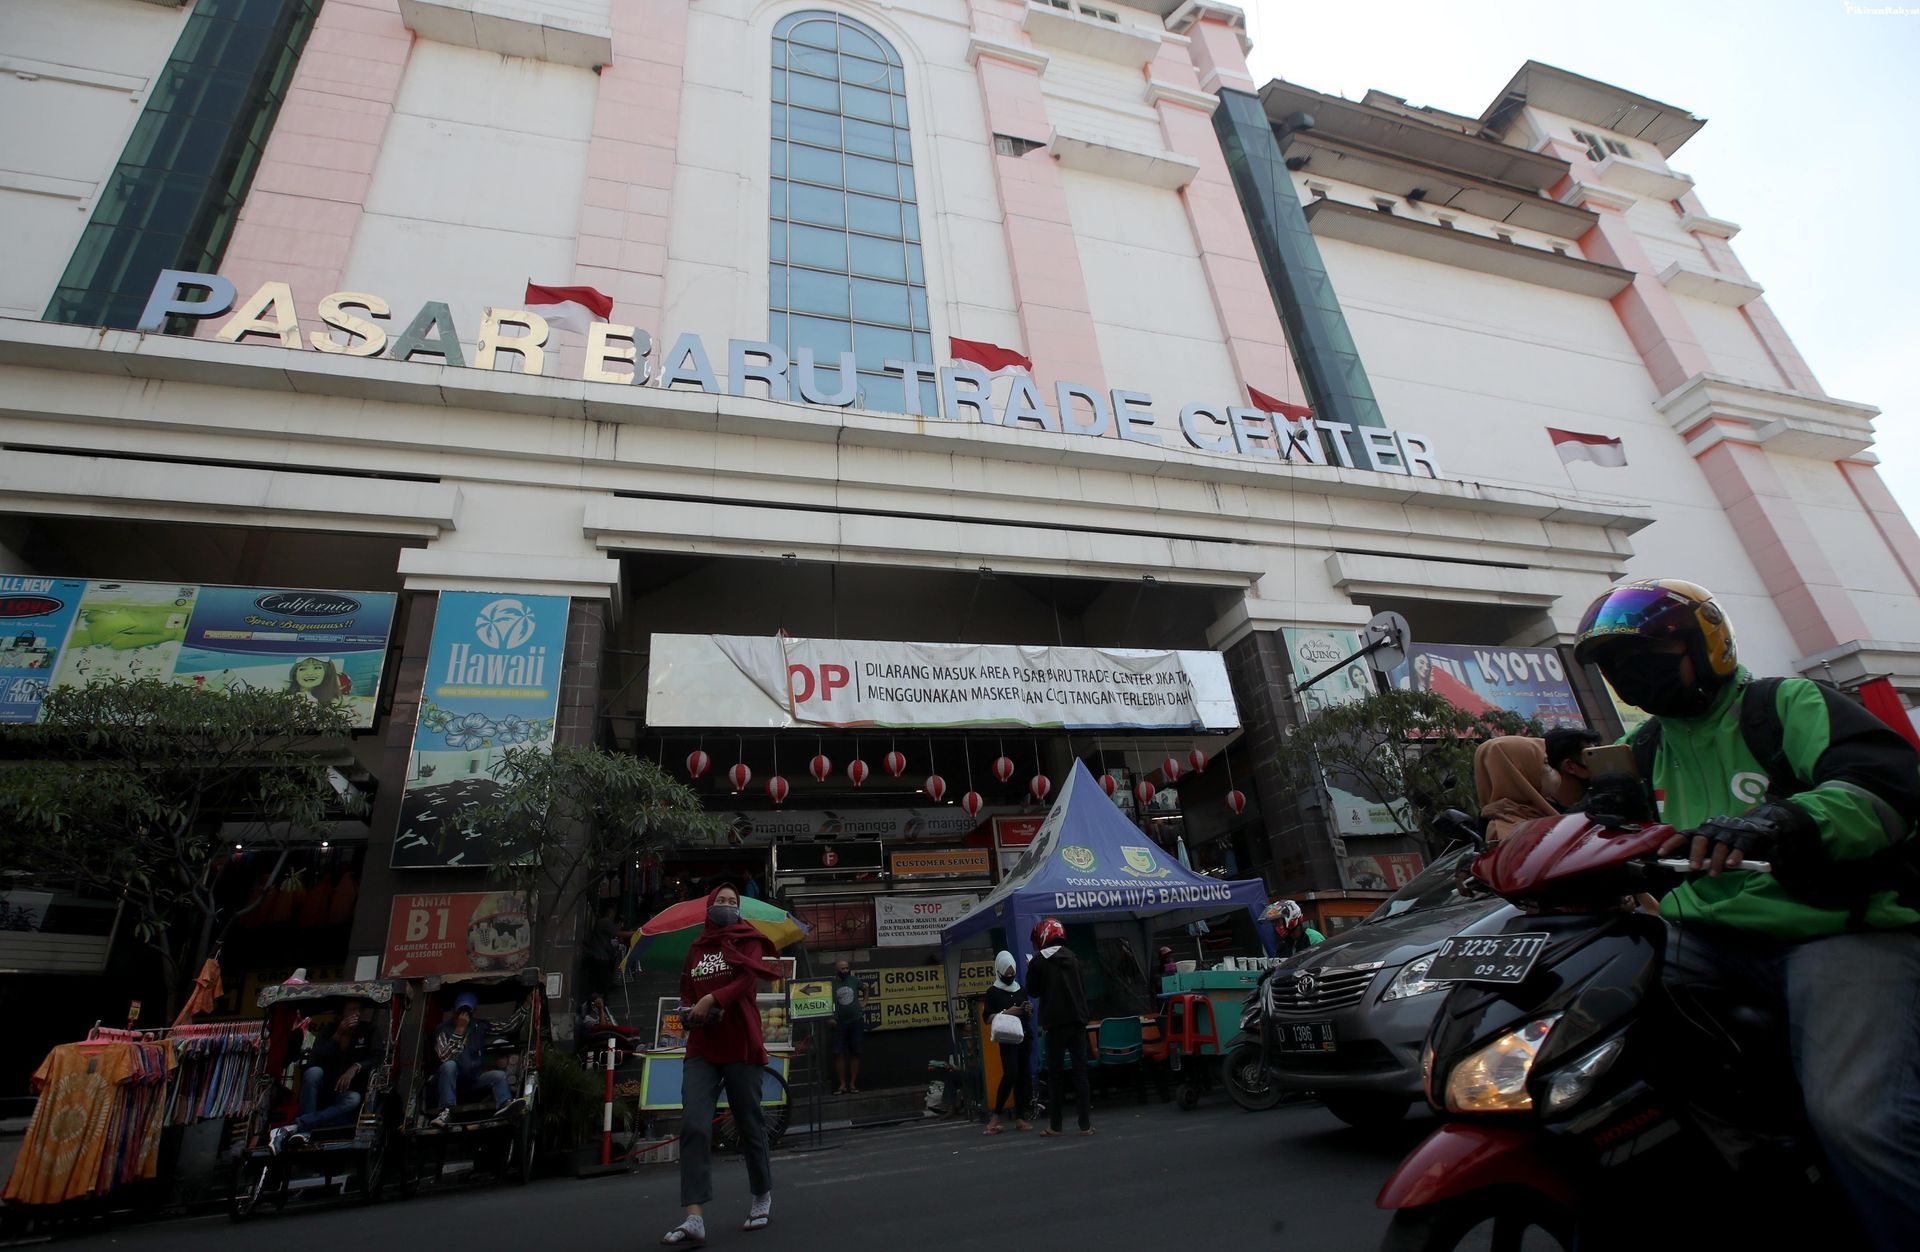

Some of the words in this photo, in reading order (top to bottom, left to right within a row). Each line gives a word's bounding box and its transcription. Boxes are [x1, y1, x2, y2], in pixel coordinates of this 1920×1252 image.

[137, 268, 549, 377] PASAR
[584, 322, 857, 407] BARU
[884, 358, 1162, 443] TRADE
[1179, 402, 1445, 478] CENTER
[260, 594, 355, 614] California
[445, 643, 546, 686] Hawaii
[1473, 650, 1564, 682] KYOTO
[866, 662, 929, 680] DILARANG
[932, 667, 977, 681] MASUK
[980, 665, 1010, 680] AREA
[1074, 669, 1109, 684] TRADE
[1113, 671, 1153, 686] CENTER
[868, 685, 967, 703] MENGGUNAKAN
[971, 687, 1019, 703] MASKER
[1069, 690, 1115, 705] TANGAN
[1117, 691, 1165, 706] TERLEBIH
[755, 823, 810, 834] mangga
[844, 819, 896, 832] mangga
[928, 816, 977, 830] mangga
[895, 859, 945, 868] CUSTOMER
[948, 857, 985, 866] SERVICE
[1066, 877, 1099, 887] POSKO
[411, 896, 451, 908] LANTAI
[1055, 889, 1122, 909] DENPOM
[1126, 887, 1155, 907] III/5
[1159, 883, 1231, 904] BANDUNG
[914, 904, 942, 914] STOP
[405, 908, 450, 942] B1
[1439, 940, 1455, 957] D
[1458, 940, 1502, 957] 3235
[1504, 938, 1543, 957] ZTT
[794, 1001, 828, 1011] MASUK
[887, 1002, 929, 1016] PASAR
[1293, 1025, 1313, 1041] 1386
